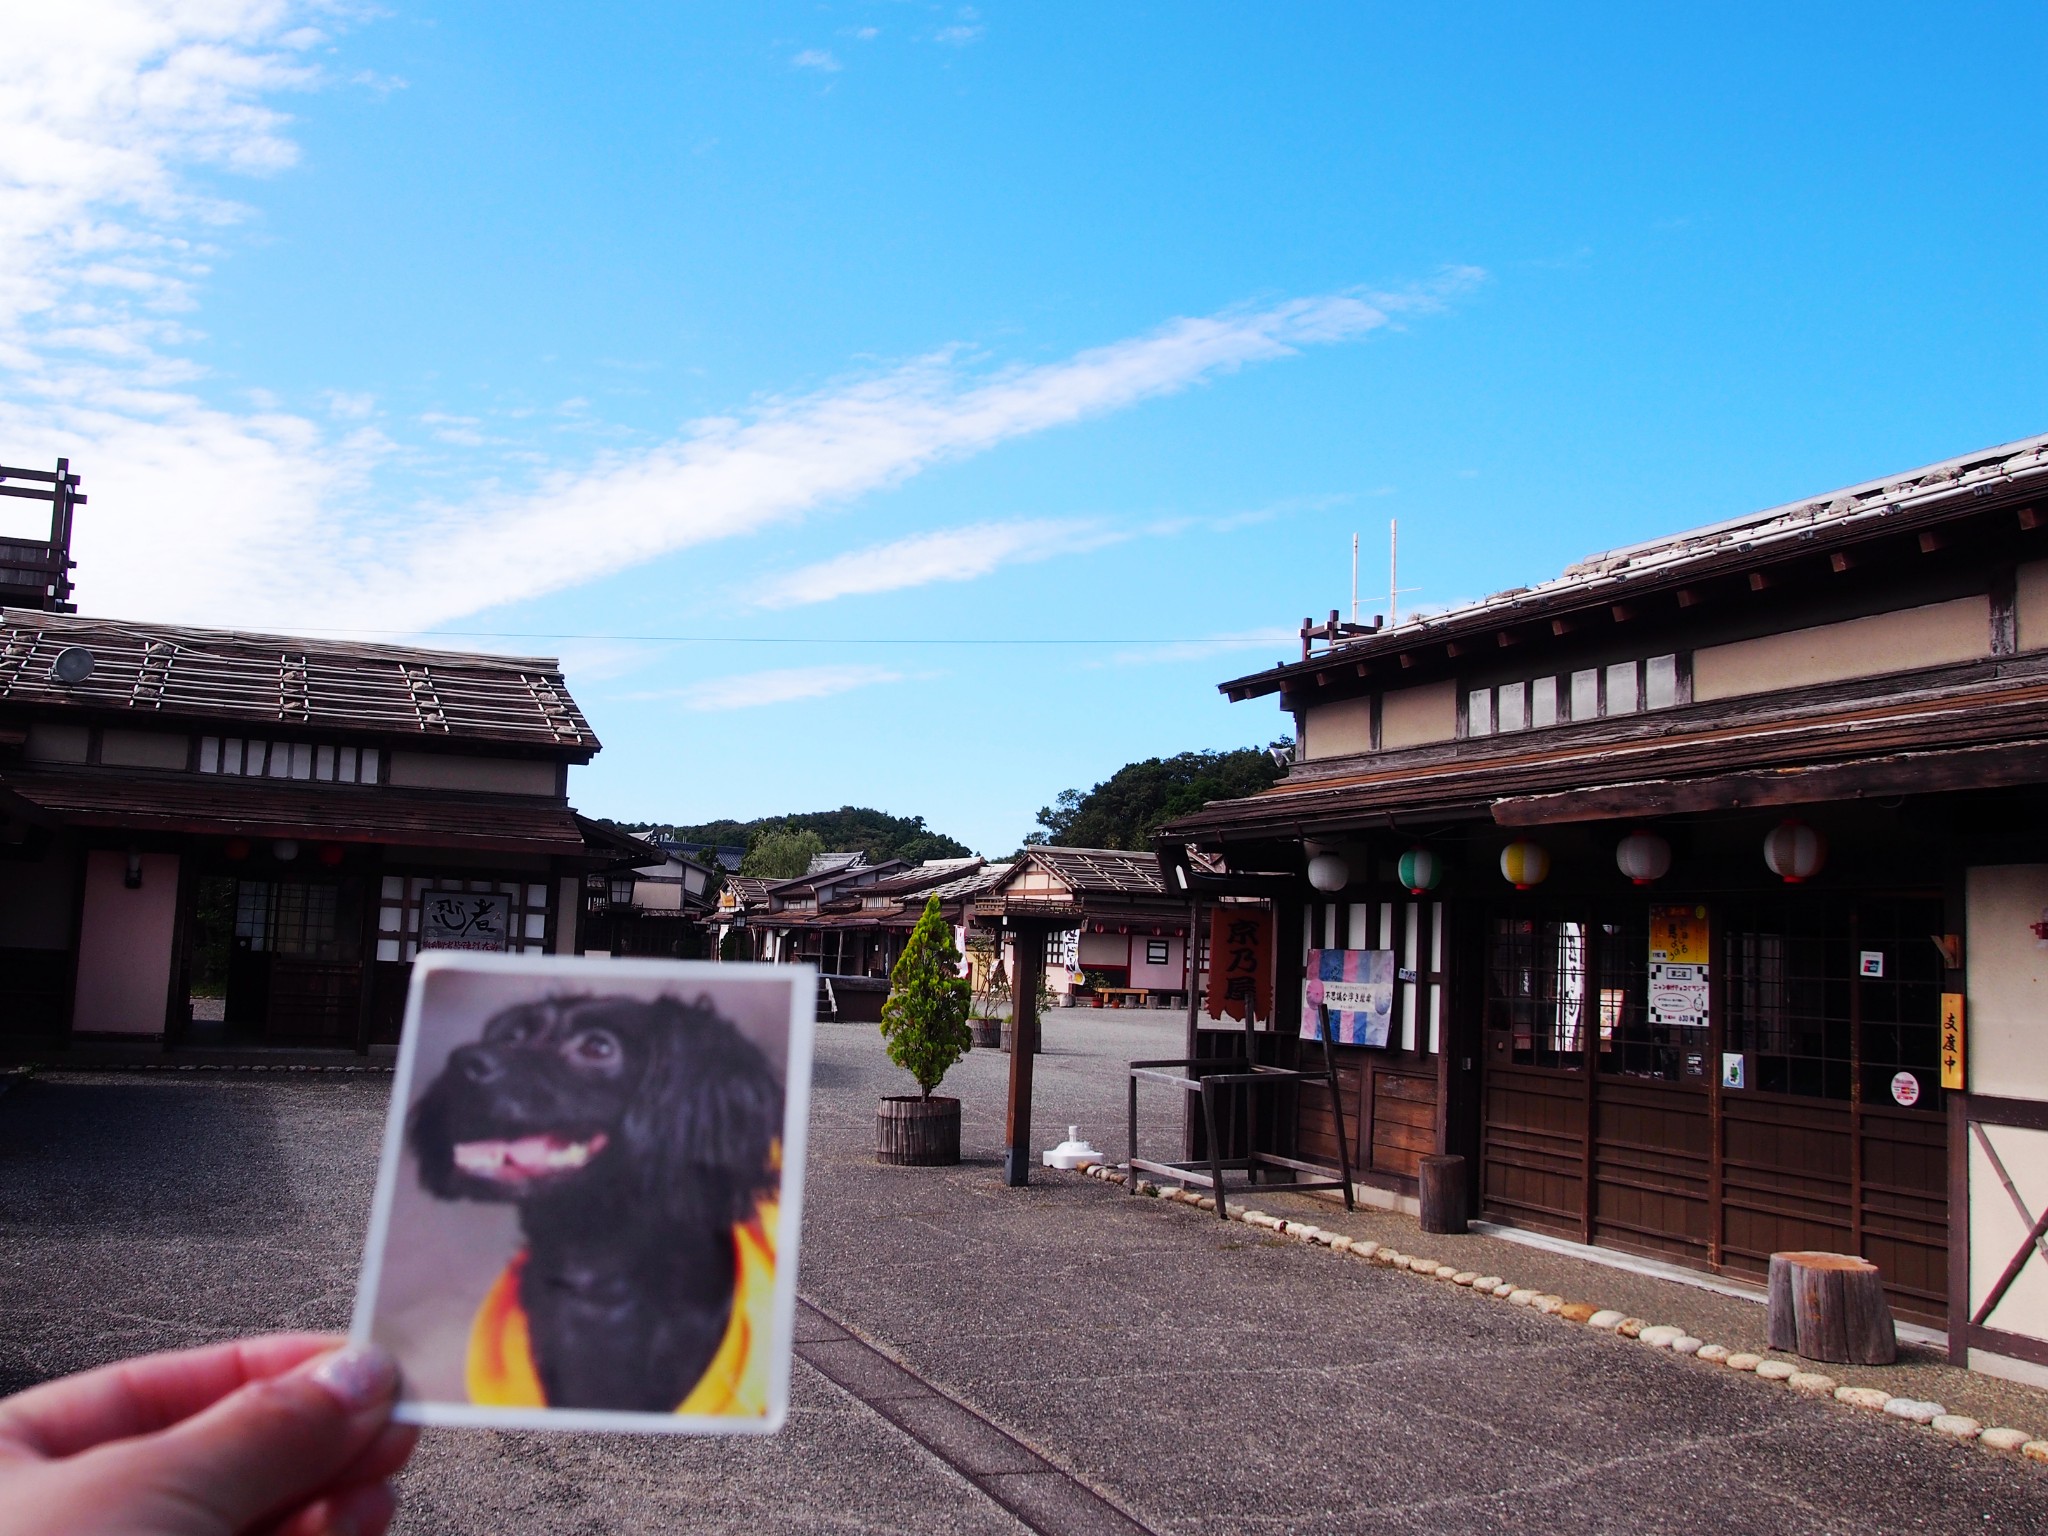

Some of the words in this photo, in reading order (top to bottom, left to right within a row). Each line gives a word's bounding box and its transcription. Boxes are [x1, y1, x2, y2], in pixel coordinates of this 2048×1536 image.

[432, 898, 497, 938] 忍者
[1224, 917, 1260, 1001] 京乃屋
[1942, 1011, 1958, 1075] 支度中
